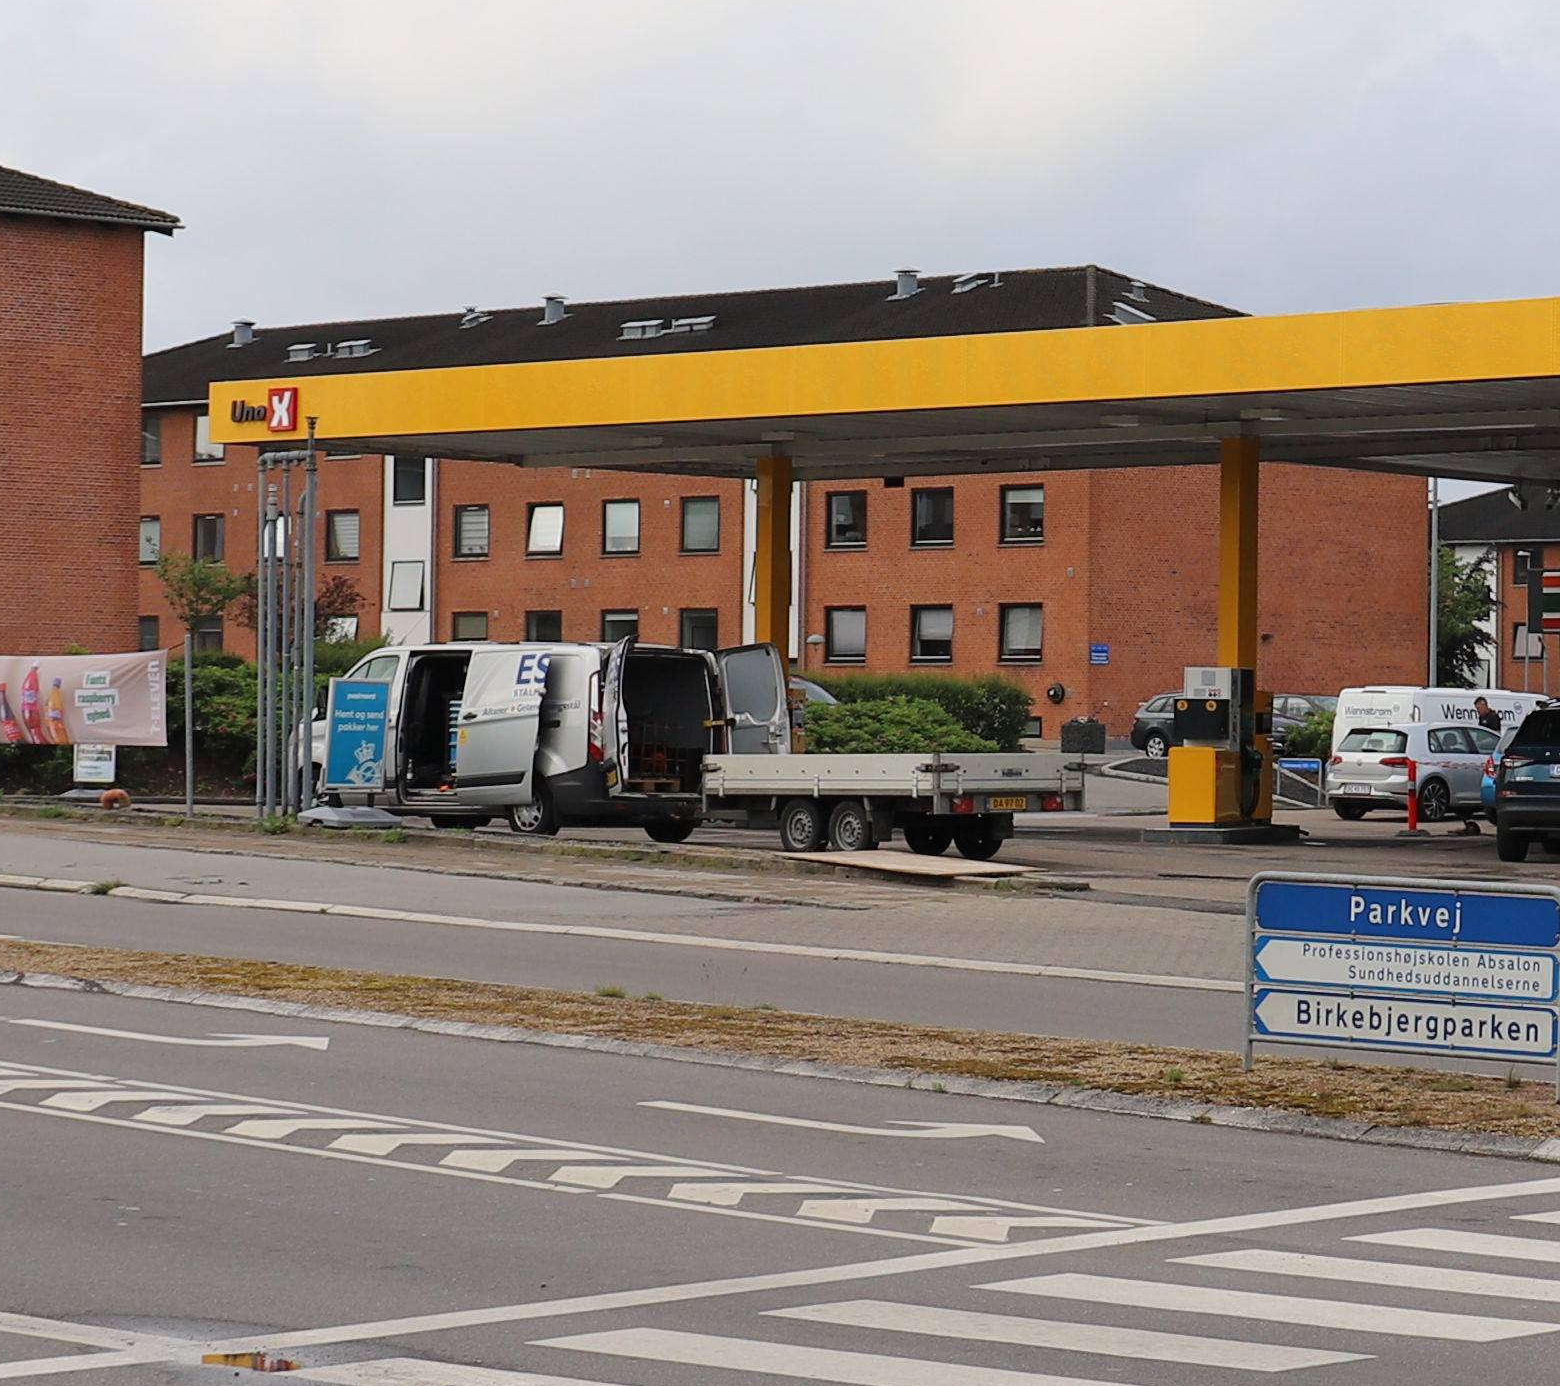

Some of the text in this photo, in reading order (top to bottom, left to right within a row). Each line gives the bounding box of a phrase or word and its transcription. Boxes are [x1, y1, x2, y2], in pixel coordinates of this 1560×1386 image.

[231, 391, 291, 427] Uno X
[355, 711, 366, 720] og
[1349, 896, 1463, 934] Parkvej
[1302, 943, 1541, 972] Professionshøjskolen Absalon
[1348, 965, 1540, 992] Sundhedsuddannelserne
[1296, 1000, 1539, 1042] Birkebjergparken
